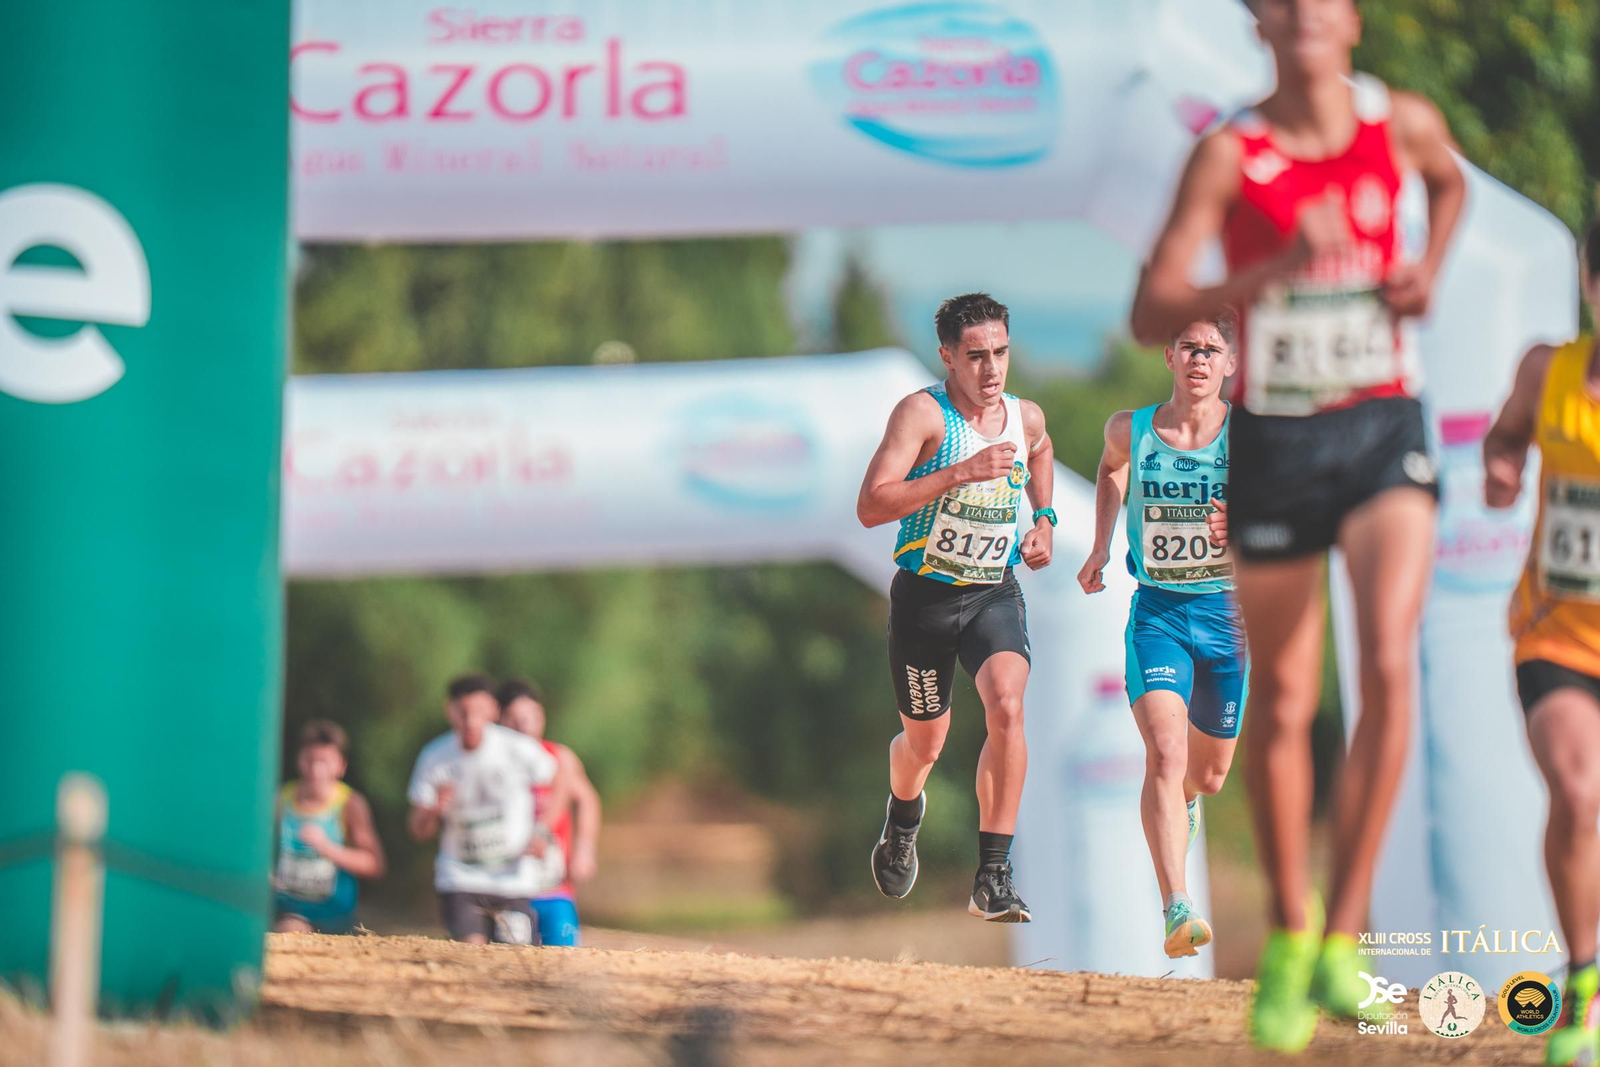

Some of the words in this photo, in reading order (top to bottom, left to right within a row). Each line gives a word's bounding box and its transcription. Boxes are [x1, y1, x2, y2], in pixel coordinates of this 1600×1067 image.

[289, 37, 688, 123] Cazorla
[289, 146, 365, 176] gua
[1141, 475, 1228, 505] nerja
[965, 506, 1003, 519] ITÁLICA
[1167, 507, 1208, 518] ITÁLICA
[936, 528, 1008, 560] 8179
[1145, 665, 1176, 675] nerja
[921, 669, 941, 713] SURCO
